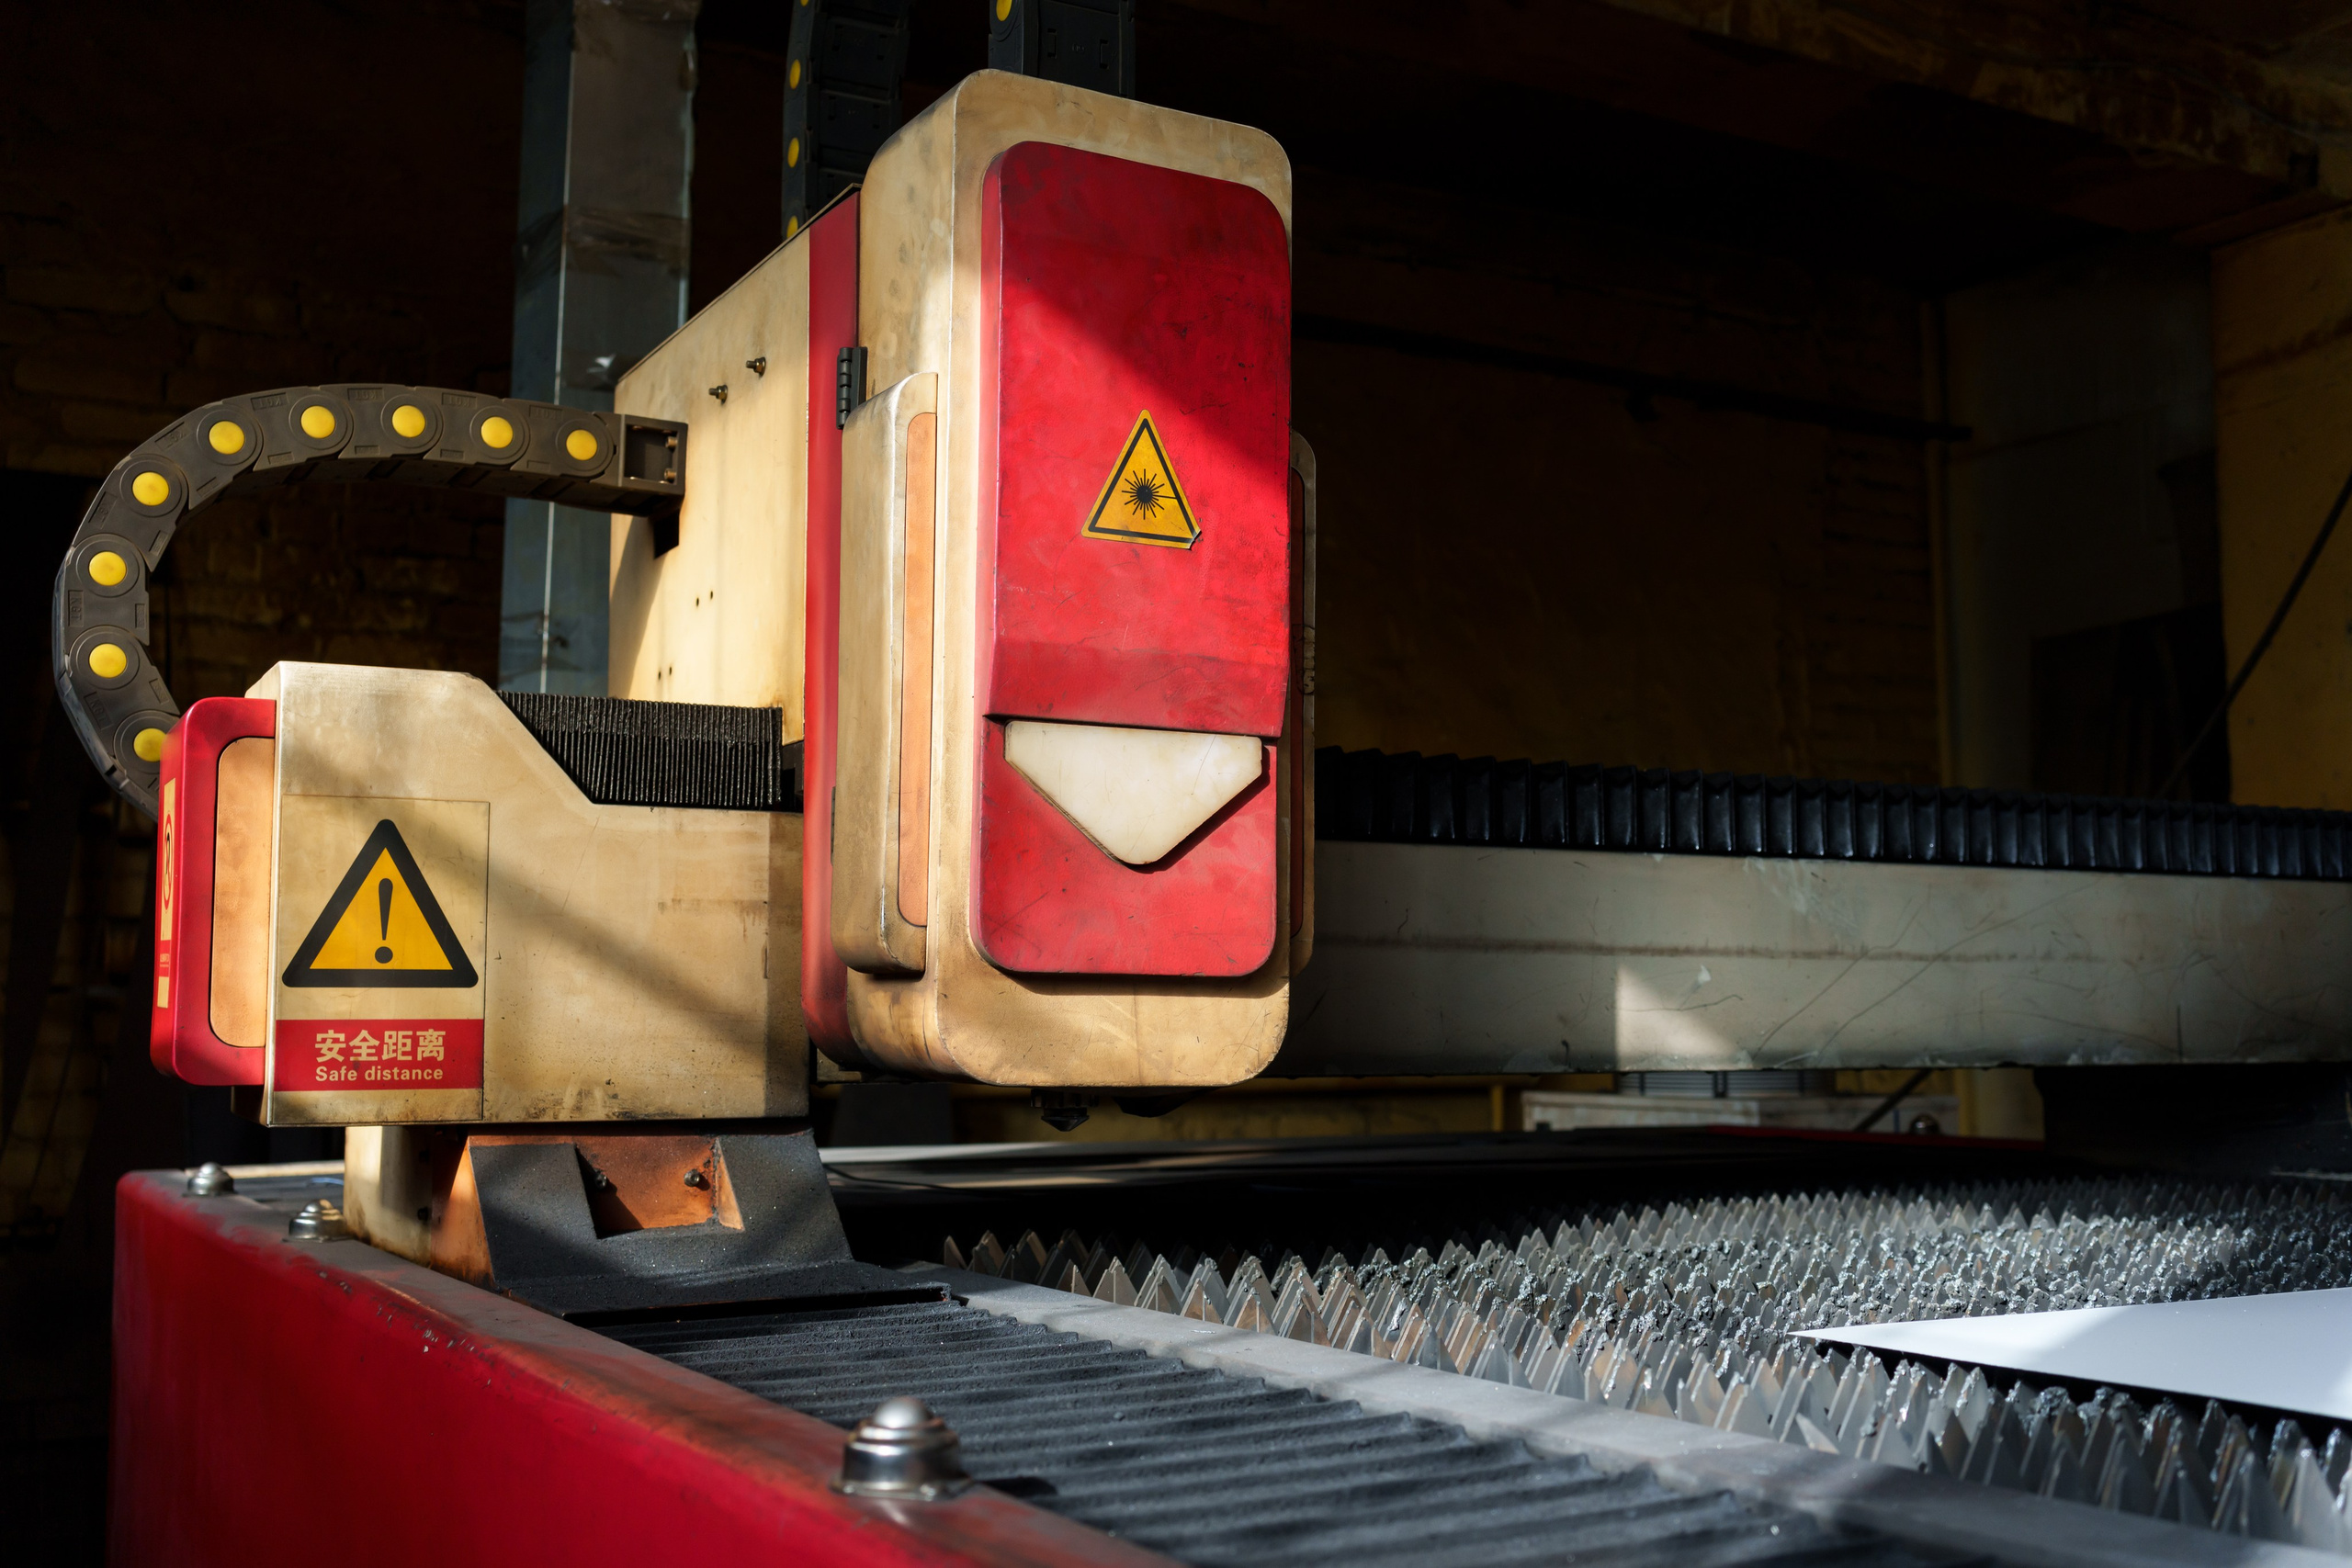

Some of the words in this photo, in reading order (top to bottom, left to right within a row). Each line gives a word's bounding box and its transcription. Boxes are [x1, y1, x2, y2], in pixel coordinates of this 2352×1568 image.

[69, 596, 81, 621] KGT
[88, 697, 110, 726] KGT
[315, 1029, 446, 1063] 安全距离
[316, 1066, 357, 1081] Safe
[365, 1066, 443, 1080] distance
